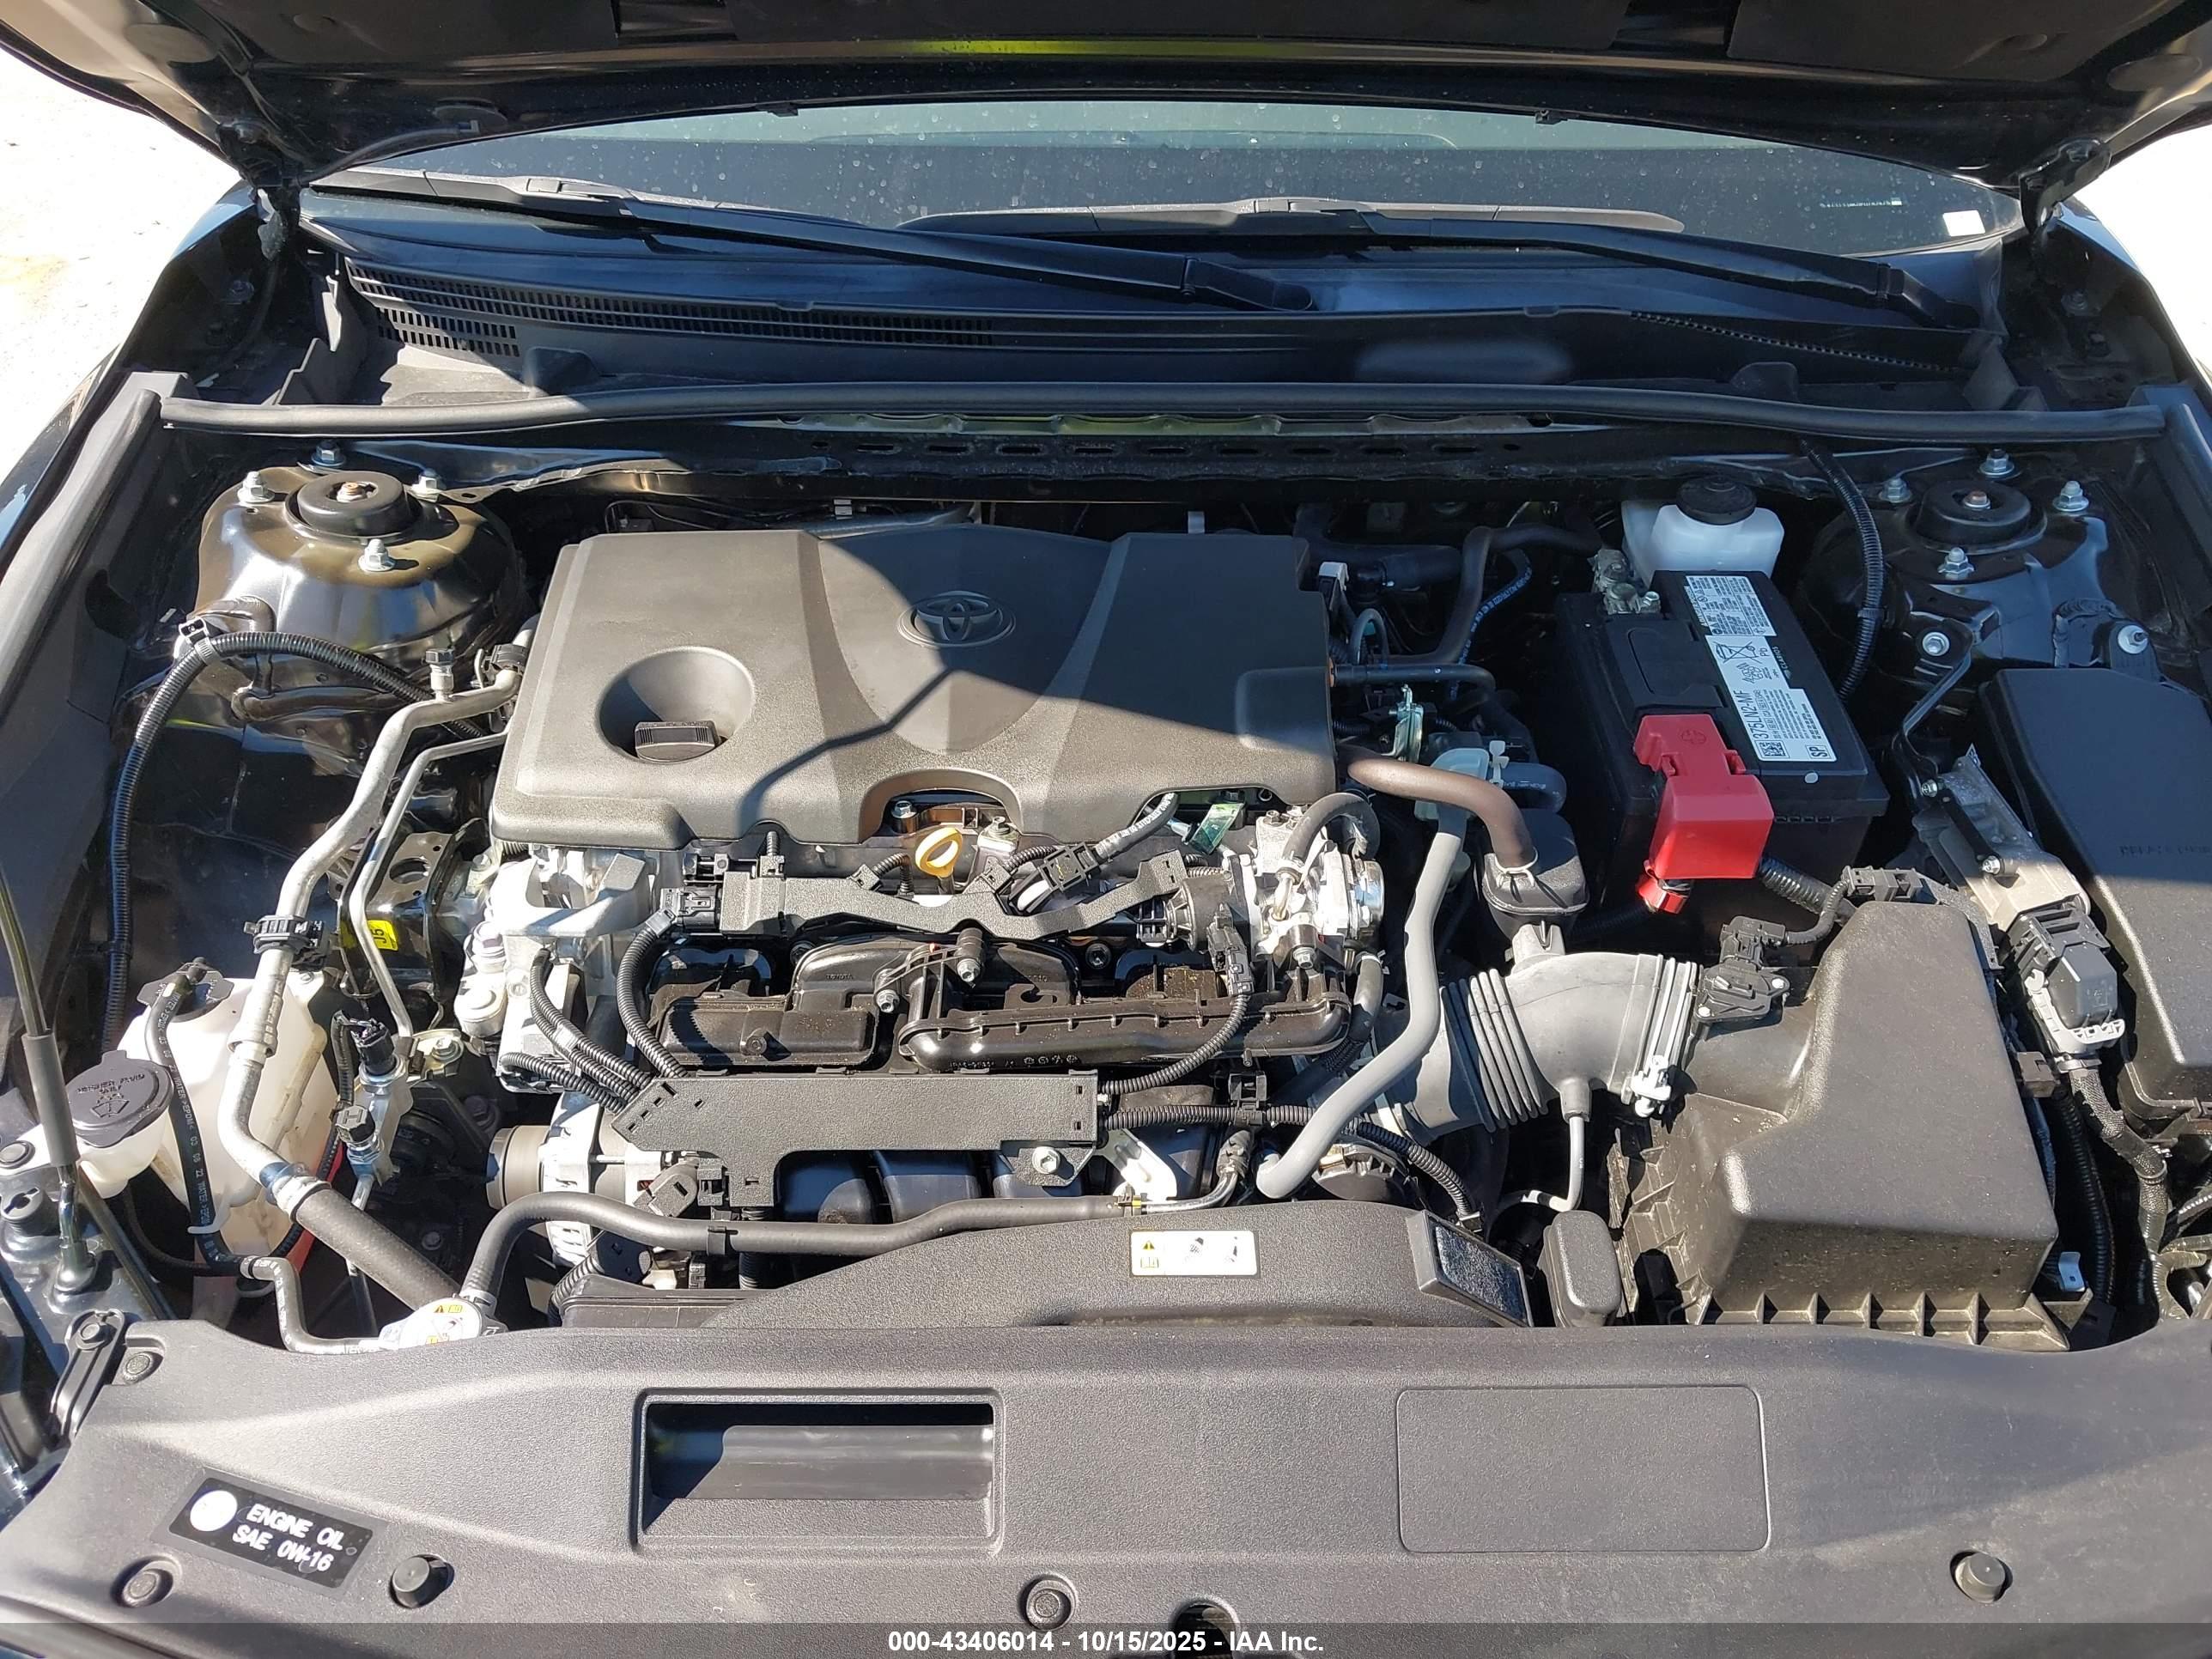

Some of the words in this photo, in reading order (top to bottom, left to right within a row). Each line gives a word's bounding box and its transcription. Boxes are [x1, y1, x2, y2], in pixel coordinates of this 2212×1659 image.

[1760, 647, 1771, 658] Pb
[1733, 690, 1769, 740] 375LN2-MF
[1811, 745, 1828, 758] SP
[173, 1076, 186, 1100] WATER
[342, 1109, 364, 1125] H
[246, 1503, 314, 1539] ENGINE
[316, 1526, 345, 1551] OIL
[232, 1524, 274, 1551] SAE
[276, 1541, 335, 1572] 0W-16
